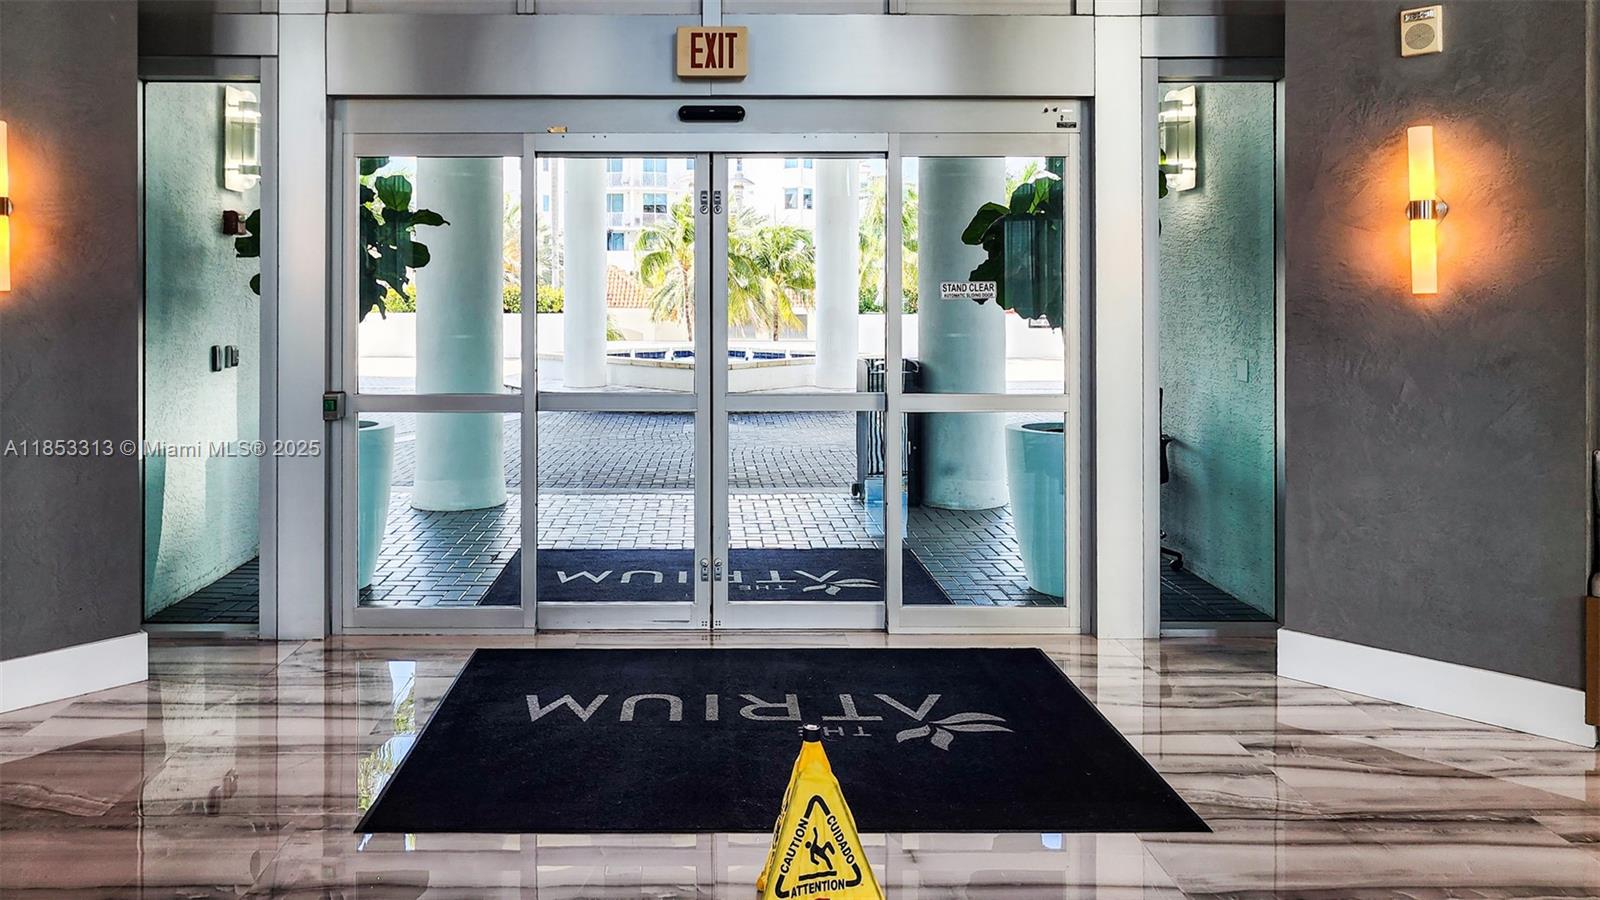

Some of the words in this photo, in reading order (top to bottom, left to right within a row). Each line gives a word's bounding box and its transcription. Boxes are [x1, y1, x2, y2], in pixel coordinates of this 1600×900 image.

[690, 32, 738, 69] EXIT
[942, 283, 967, 292] STAND
[969, 283, 994, 292] CLEAR
[526, 693, 942, 722] ATRIUM
[798, 725, 872, 737] TH
[780, 817, 809, 874] CAUTION
[826, 815, 856, 864] CUIDADO
[790, 879, 845, 899] ATTENTION
